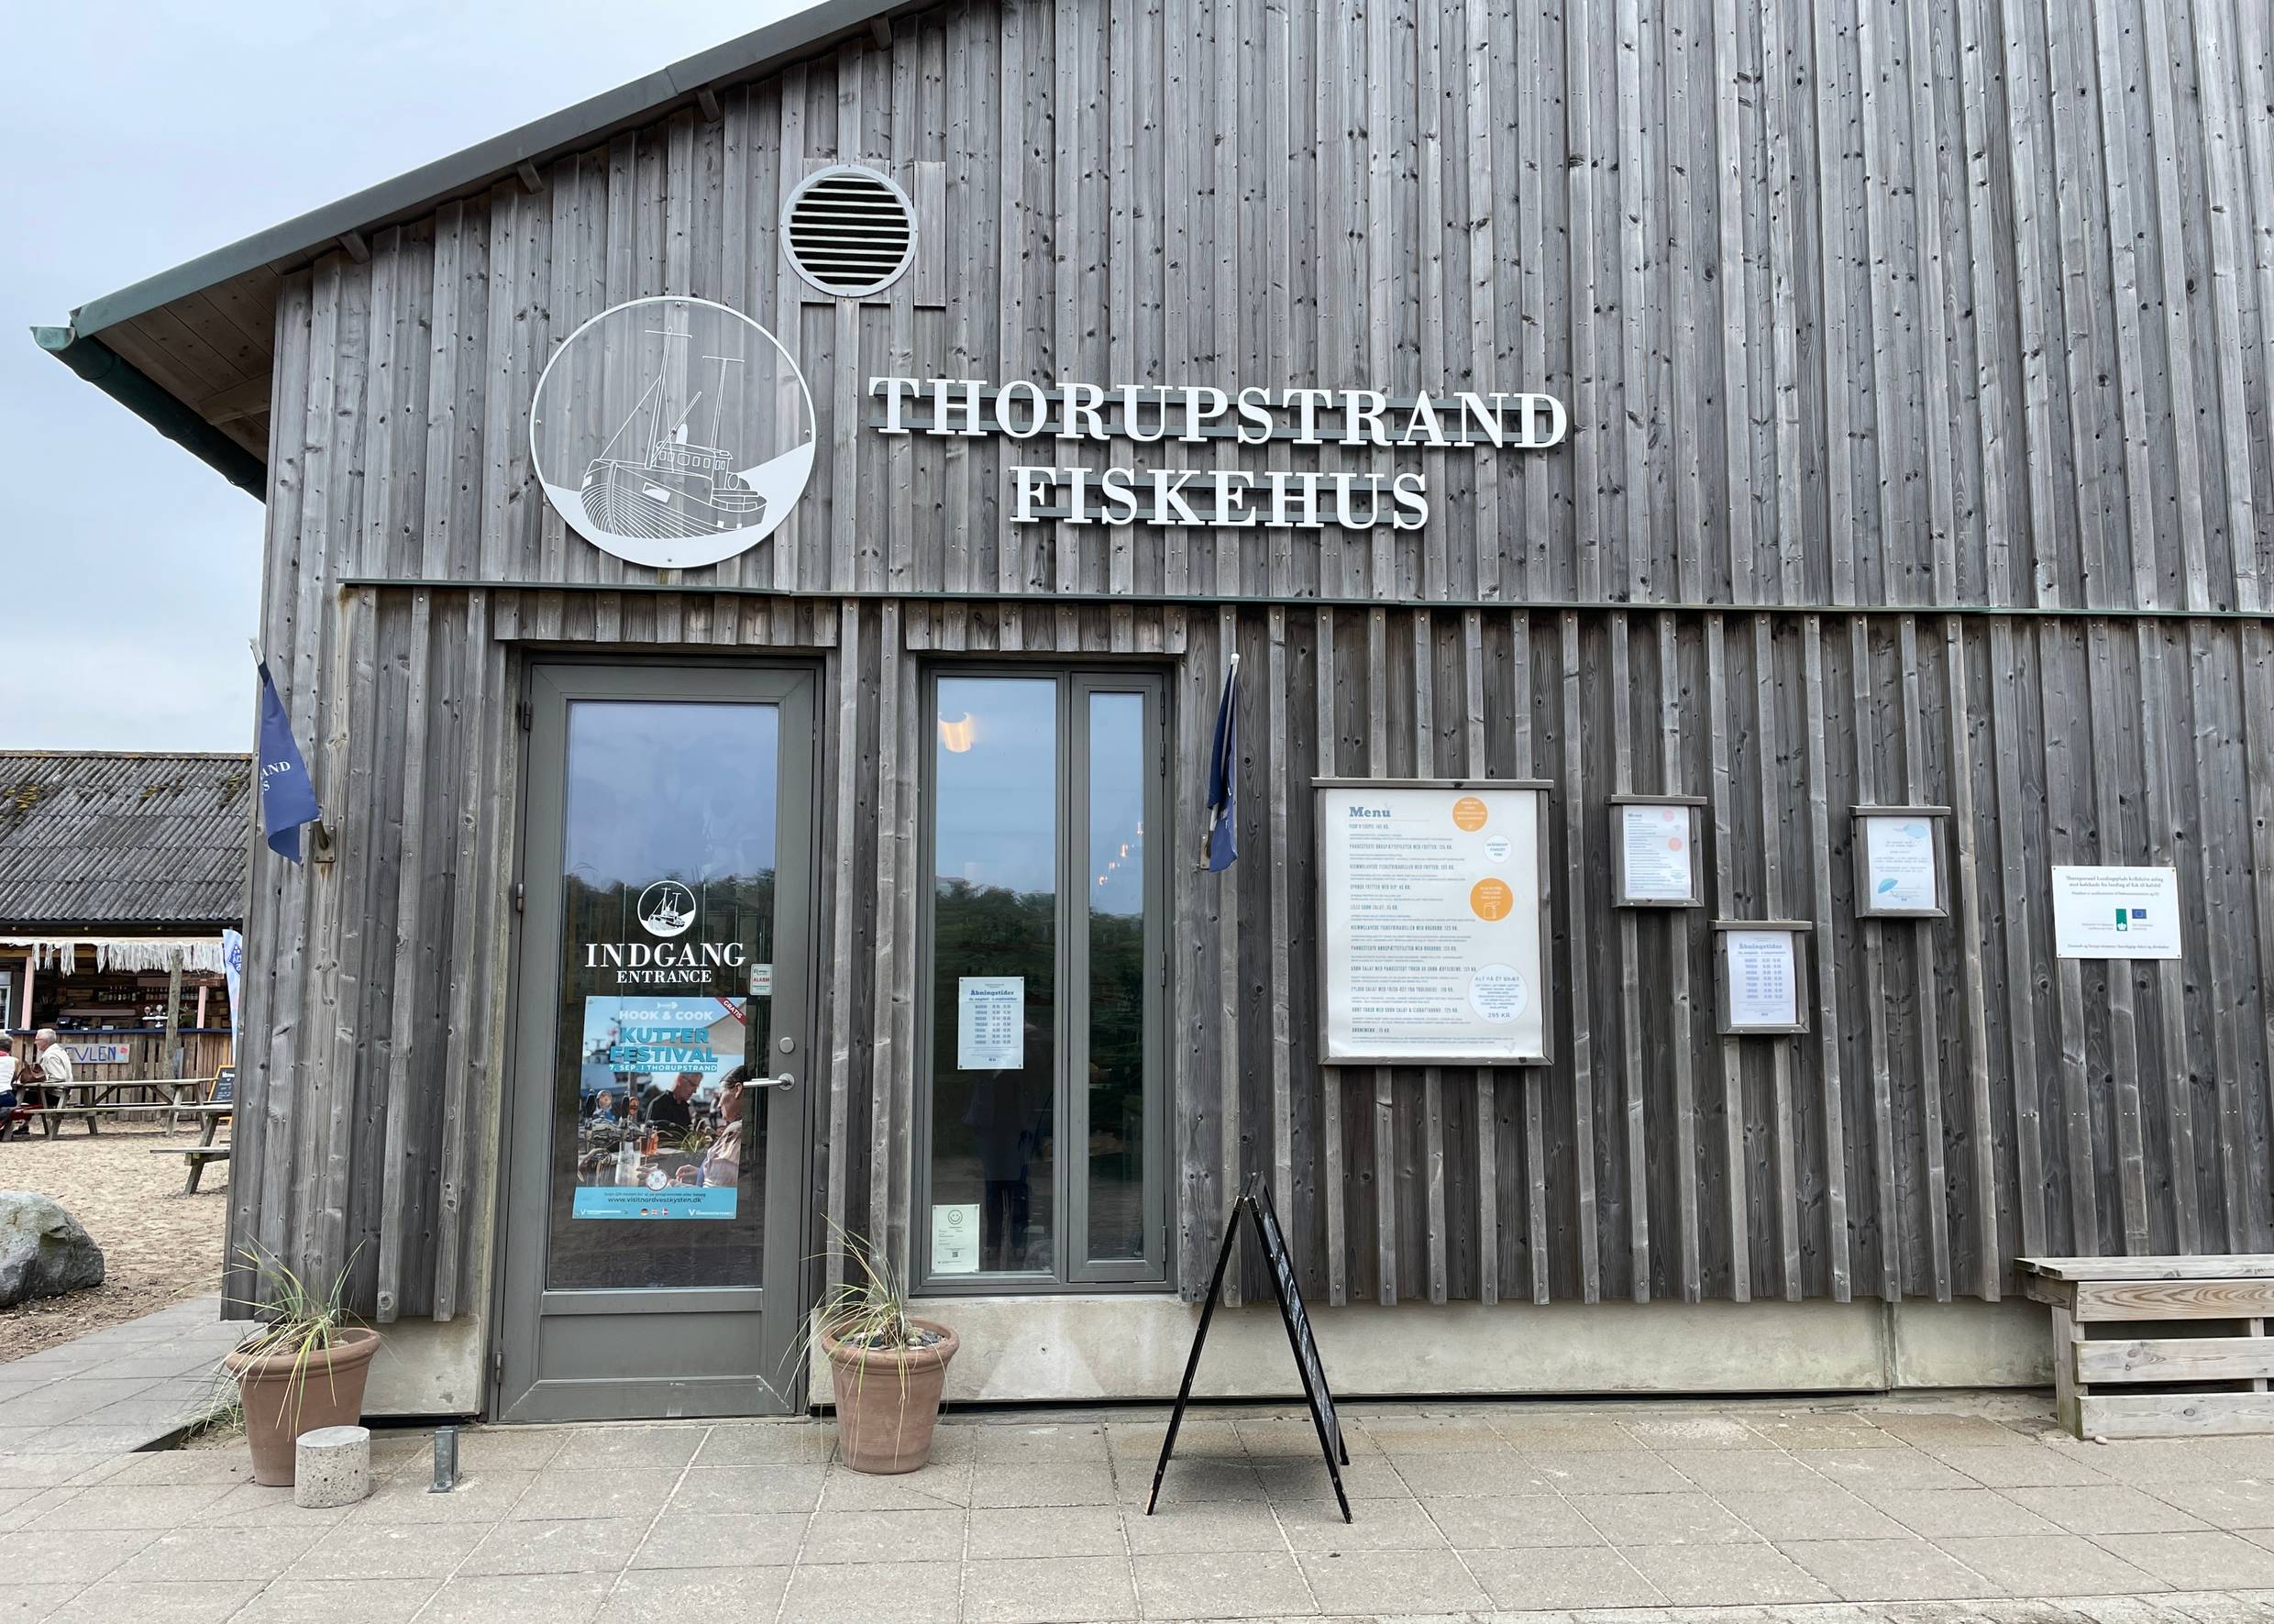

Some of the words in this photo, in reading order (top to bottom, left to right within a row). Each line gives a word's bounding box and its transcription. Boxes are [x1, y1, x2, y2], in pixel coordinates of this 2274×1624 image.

[868, 376, 1568, 449] THORUPSTRAND
[1010, 466, 1429, 530] FISKEHUS
[1349, 806, 1391, 818] Menu
[585, 943, 746, 967] INDGANG
[616, 970, 712, 984] ENTRANCE
[619, 1011, 658, 1021] HOOK
[663, 1011, 672, 1021] &
[675, 1011, 713, 1021] COOK
[723, 1000, 743, 1020] GRATIS
[620, 1027, 710, 1044] KUTTER
[610, 1045, 719, 1064] FESTIVAL
